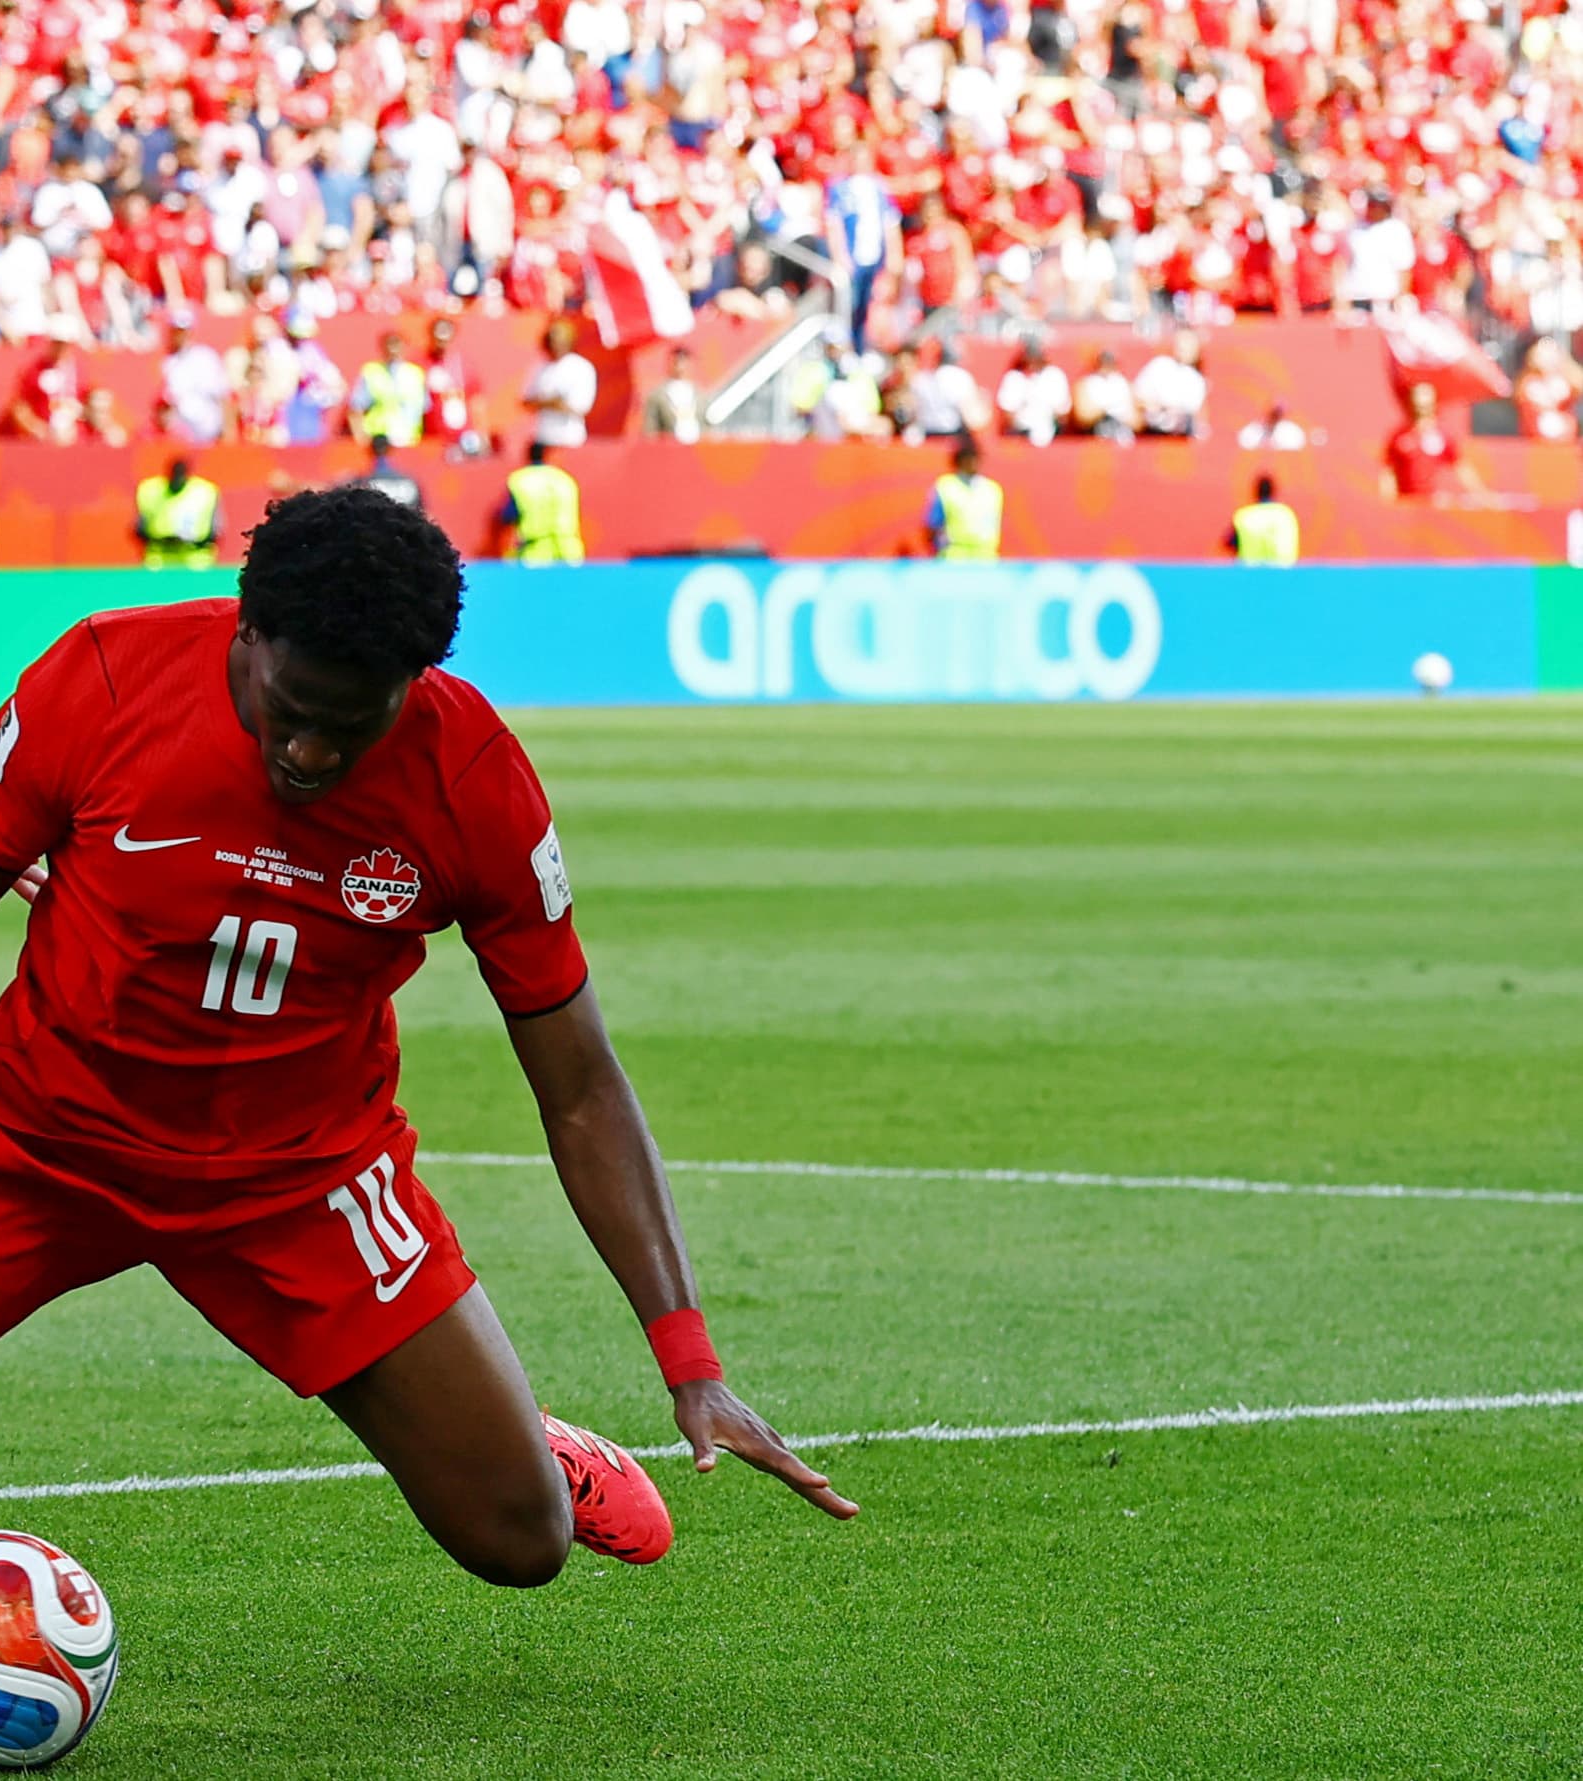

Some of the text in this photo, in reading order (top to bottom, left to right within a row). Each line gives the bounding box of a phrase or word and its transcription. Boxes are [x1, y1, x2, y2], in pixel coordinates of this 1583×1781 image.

[215, 850, 324, 883] BOSNIA AND HERZEGOVINA
[254, 847, 287, 861] CANADA
[253, 870, 273, 883] JUNE
[344, 877, 415, 895] CANADA
[201, 915, 297, 1016] 10
[326, 1152, 425, 1278] 10
